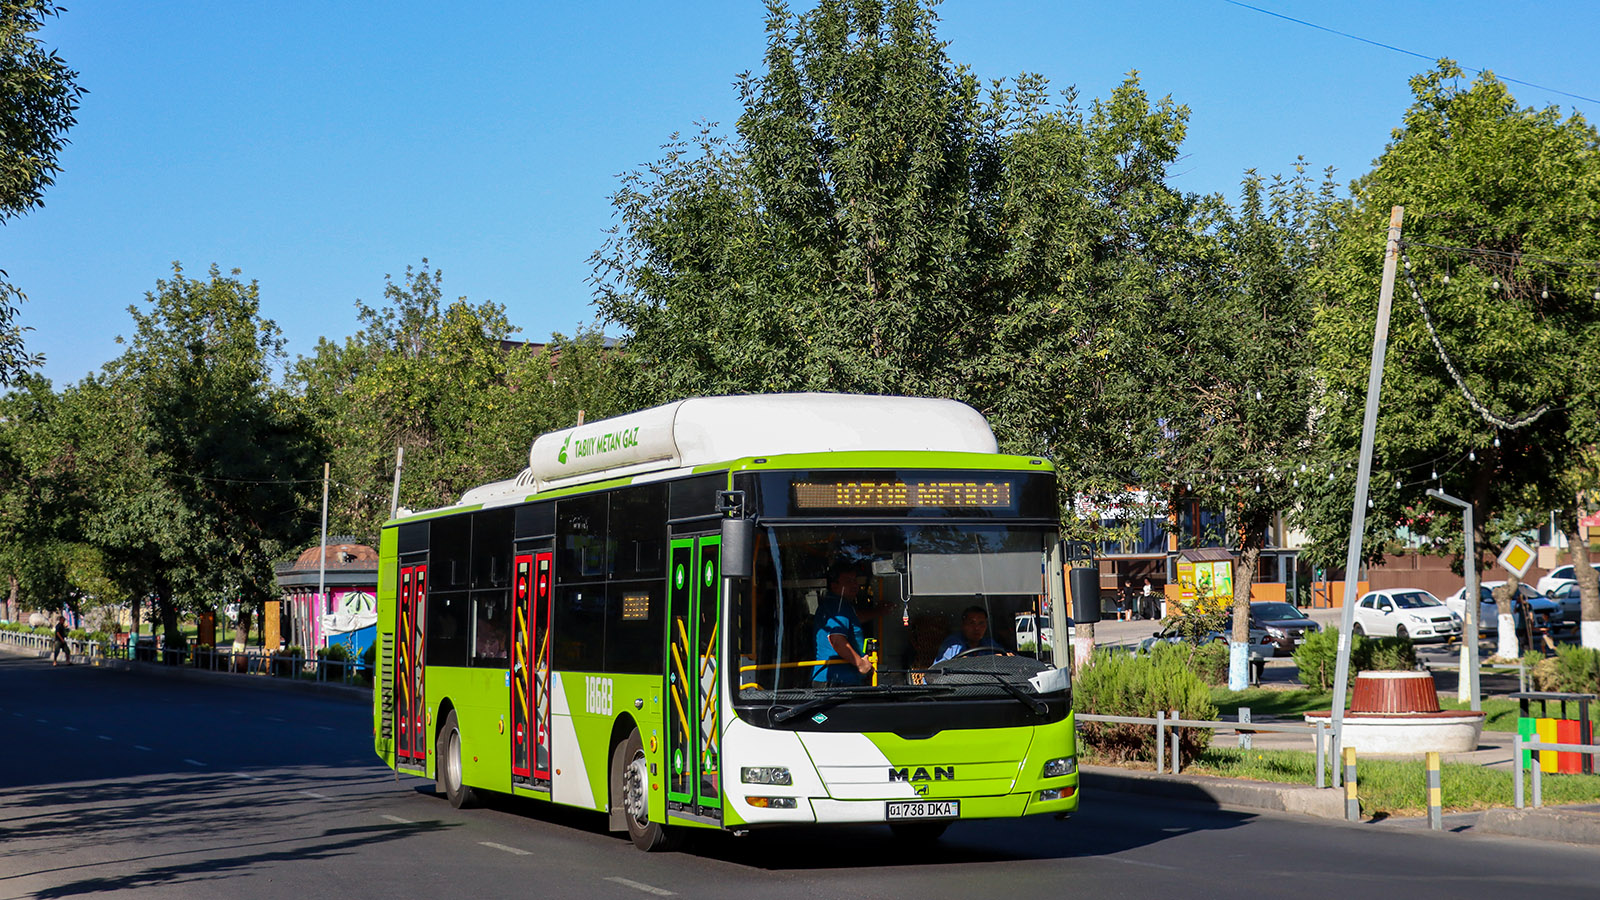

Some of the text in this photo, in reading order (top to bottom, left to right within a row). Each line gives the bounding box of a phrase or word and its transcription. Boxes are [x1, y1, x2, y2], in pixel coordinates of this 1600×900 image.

[597, 431, 622, 454] METAN
[623, 427, 639, 448] GAZ
[585, 676, 613, 716] 18683
[888, 766, 955, 782] MAN
[890, 802, 952, 816] 01 738 DKA
